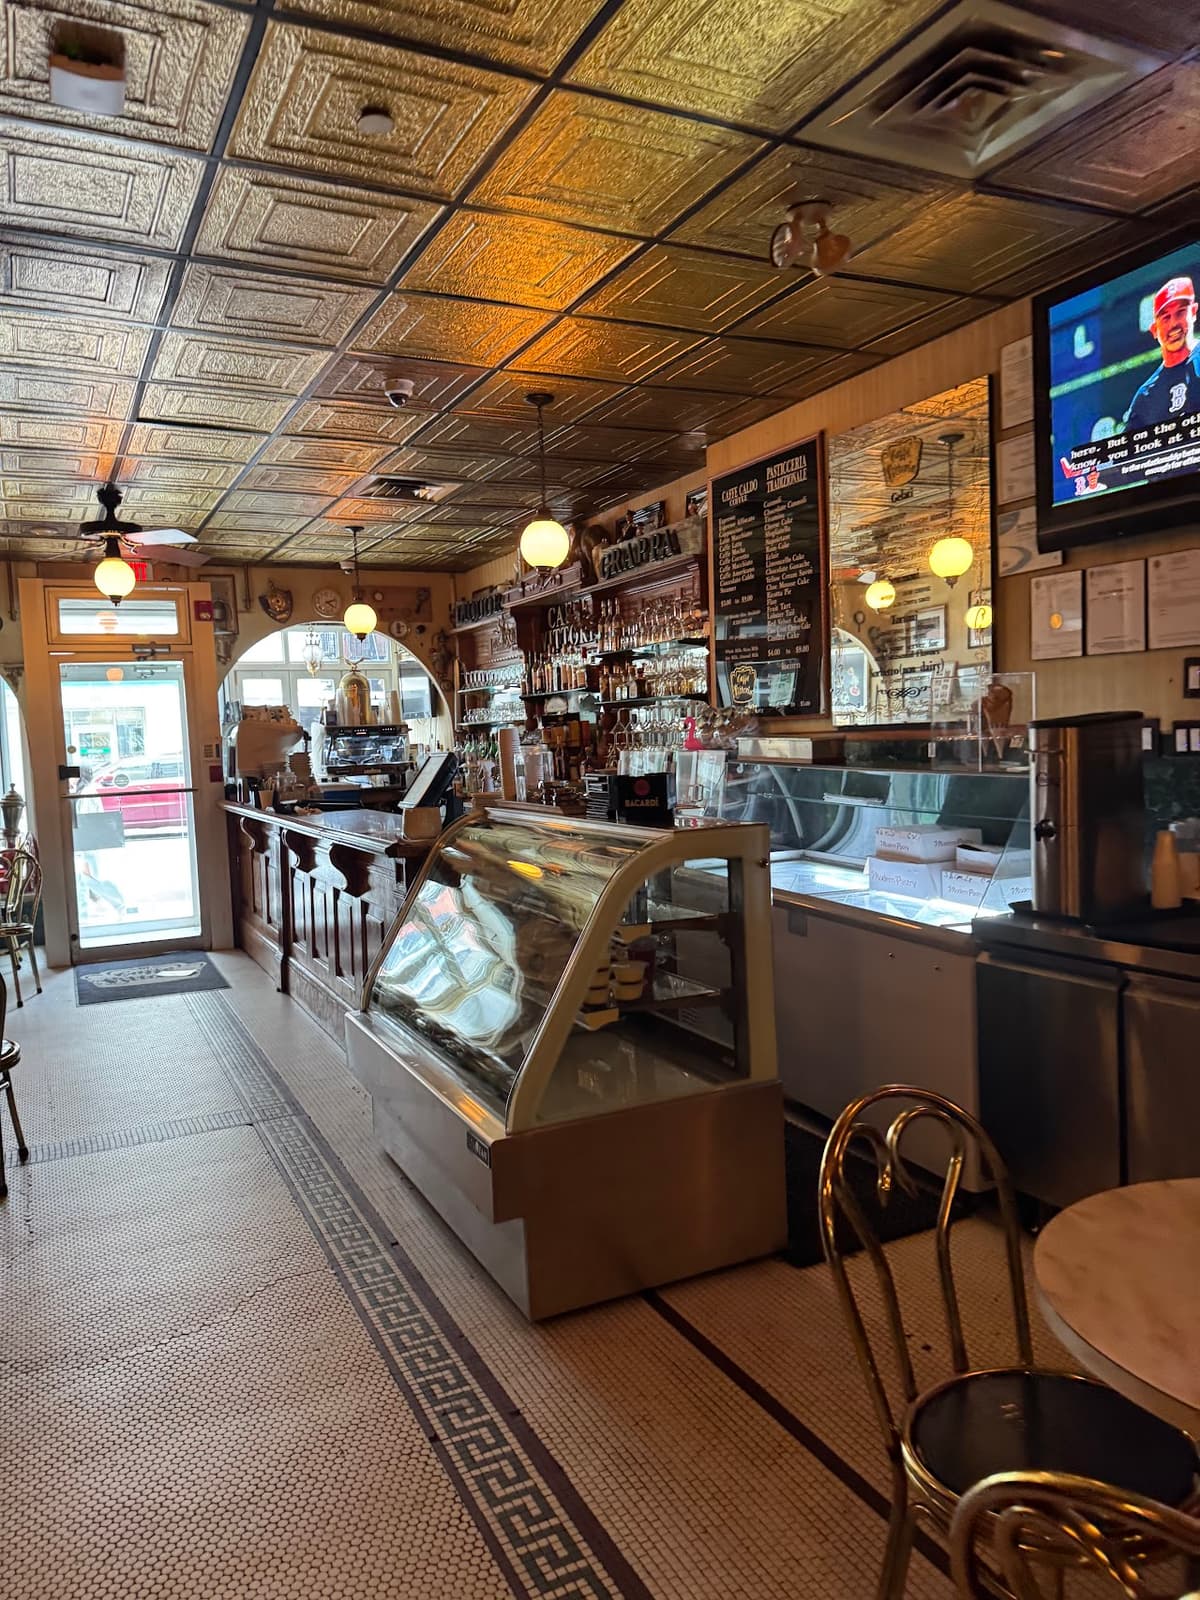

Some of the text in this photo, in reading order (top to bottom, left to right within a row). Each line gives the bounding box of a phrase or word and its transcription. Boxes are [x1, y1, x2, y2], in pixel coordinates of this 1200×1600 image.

[1070, 447, 1101, 460] here.
[1107, 436, 1129, 449] But
[1133, 430, 1149, 441] on
[1153, 422, 1177, 435] the
[1107, 449, 1129, 461] you
[1134, 438, 1162, 454] look
[1167, 432, 1184, 444] at
[766, 455, 807, 481] PASTICCERIA
[766, 467, 808, 493] TRADIZIONALE
[601, 528, 682, 581] GRAPPA
